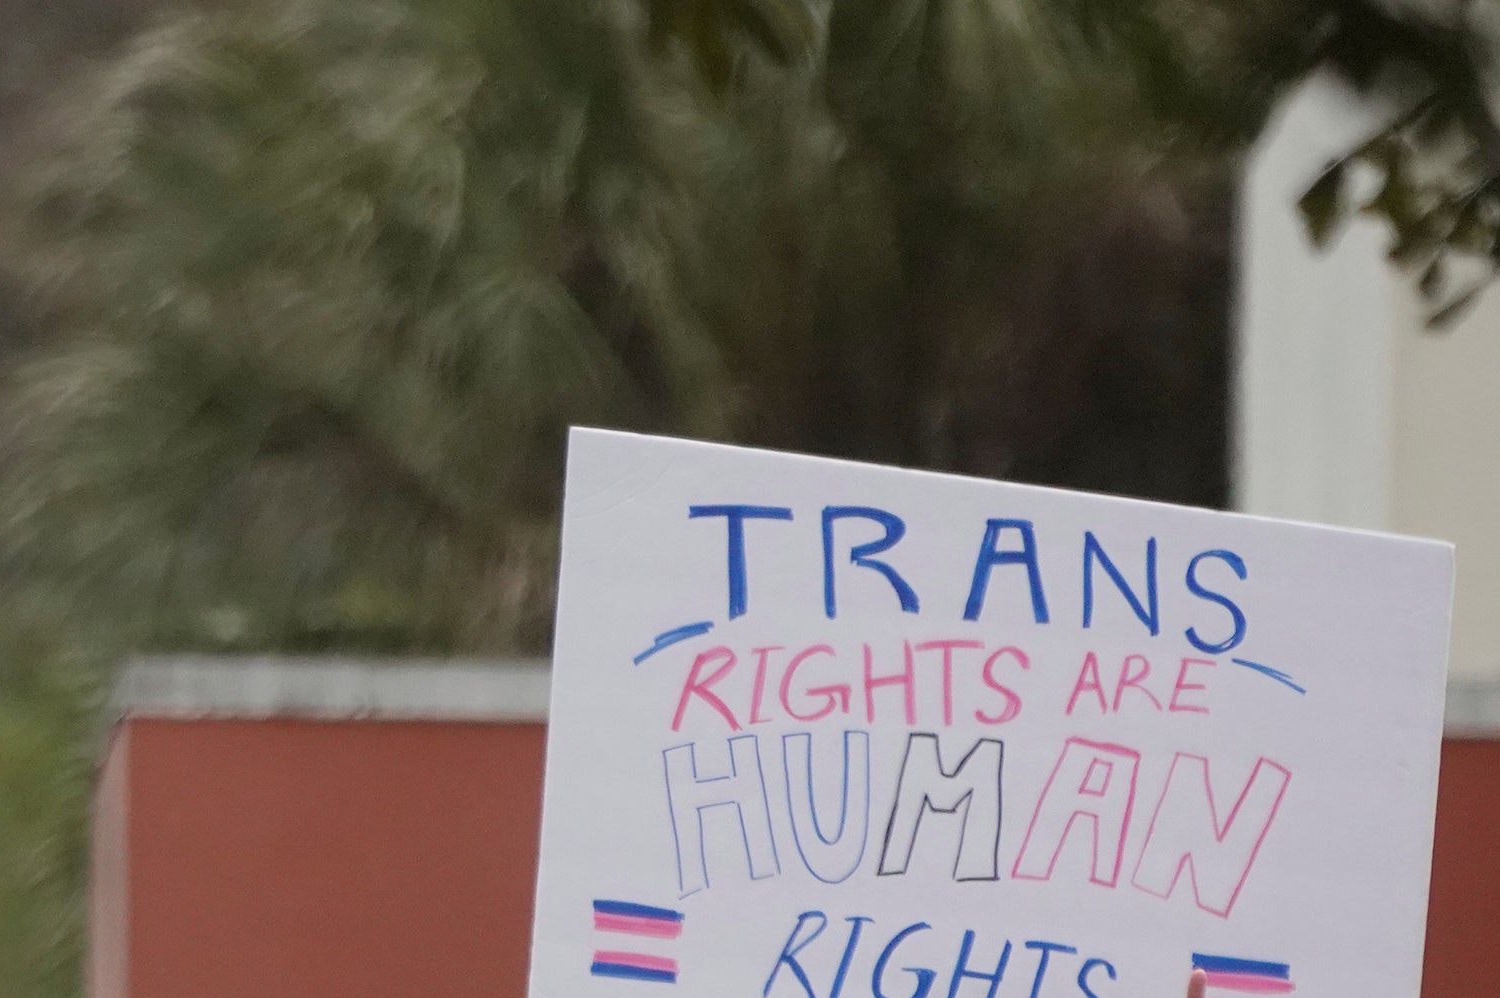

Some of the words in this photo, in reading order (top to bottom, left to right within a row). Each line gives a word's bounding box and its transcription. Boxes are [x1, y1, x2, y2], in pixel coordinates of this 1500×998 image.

[690, 504, 1248, 653] TRANS
[671, 640, 1031, 731] RIGHTS
[1065, 652, 1218, 717] ARE
[662, 730, 1292, 918] HUMAN
